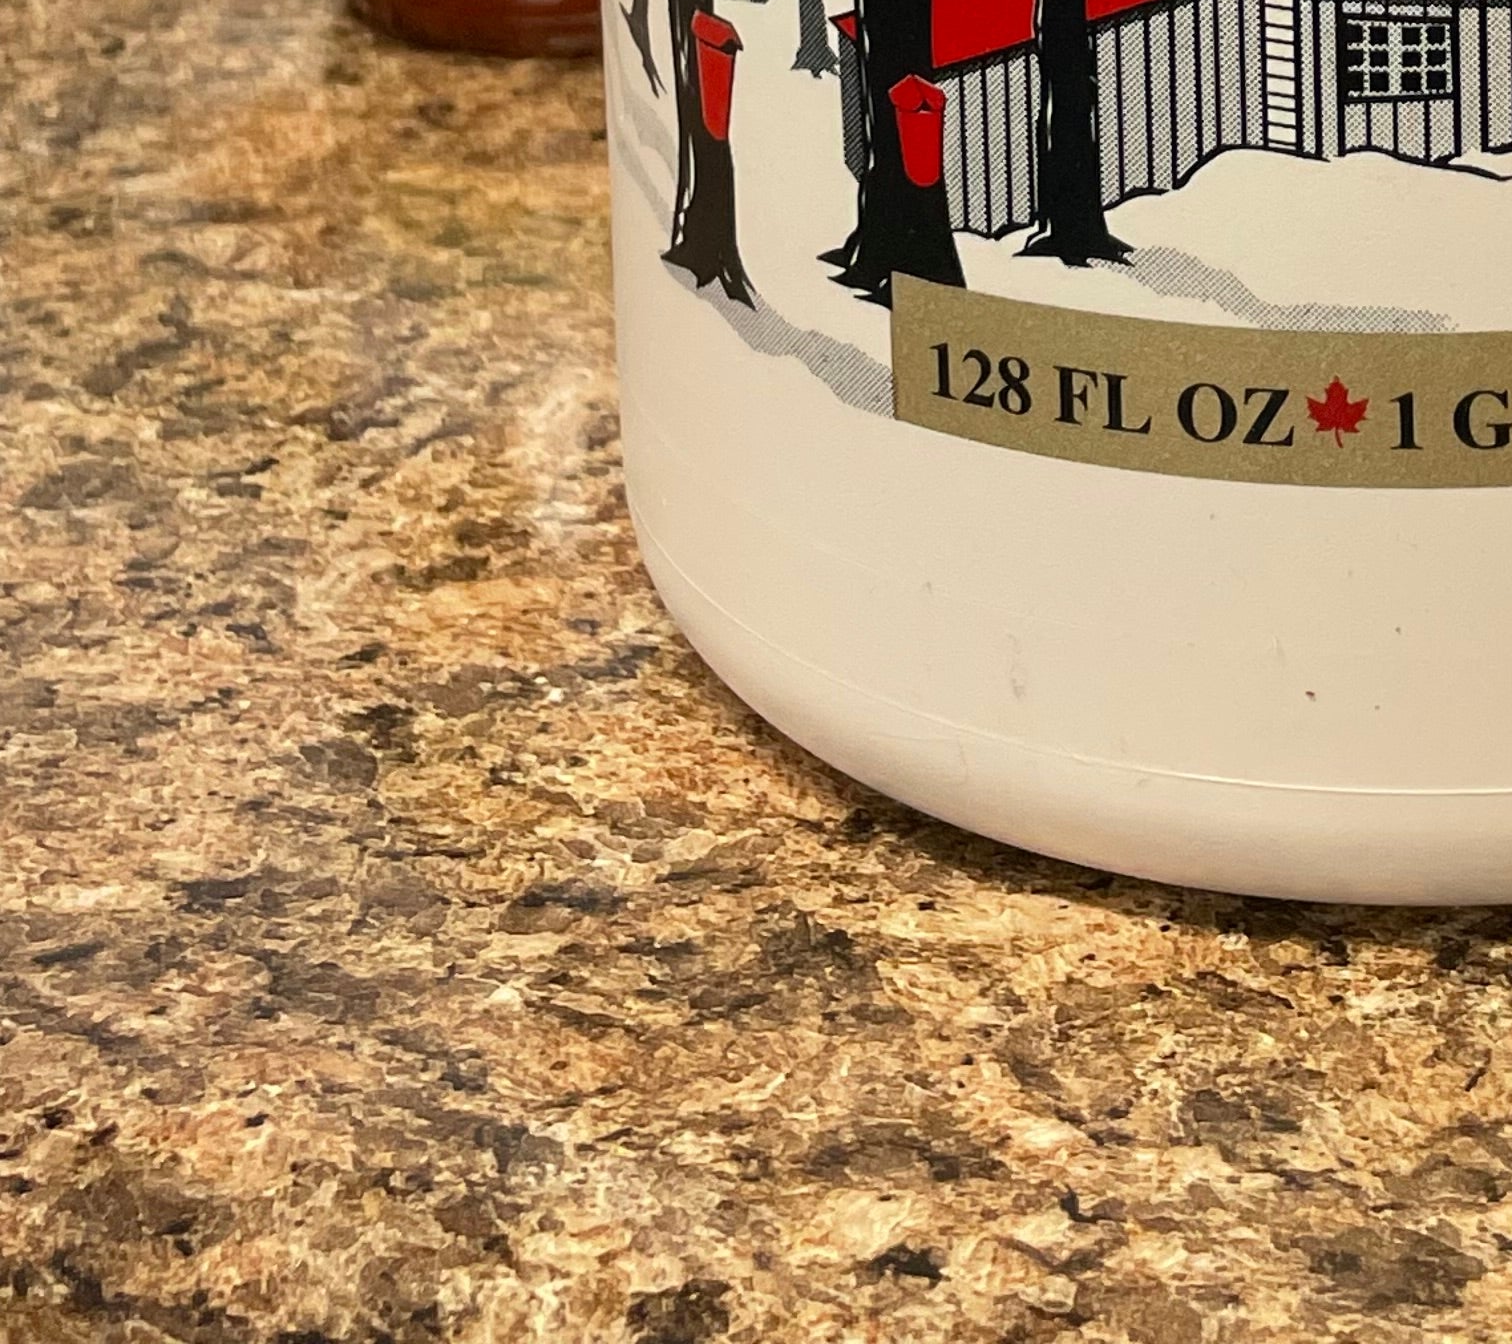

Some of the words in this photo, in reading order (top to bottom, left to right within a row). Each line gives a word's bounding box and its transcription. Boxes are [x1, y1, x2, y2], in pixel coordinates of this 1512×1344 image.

[928, 339, 1033, 417] 128
[1052, 365, 1152, 436] FL
[1176, 381, 1297, 449] OZ
[1389, 391, 1420, 452] 1
